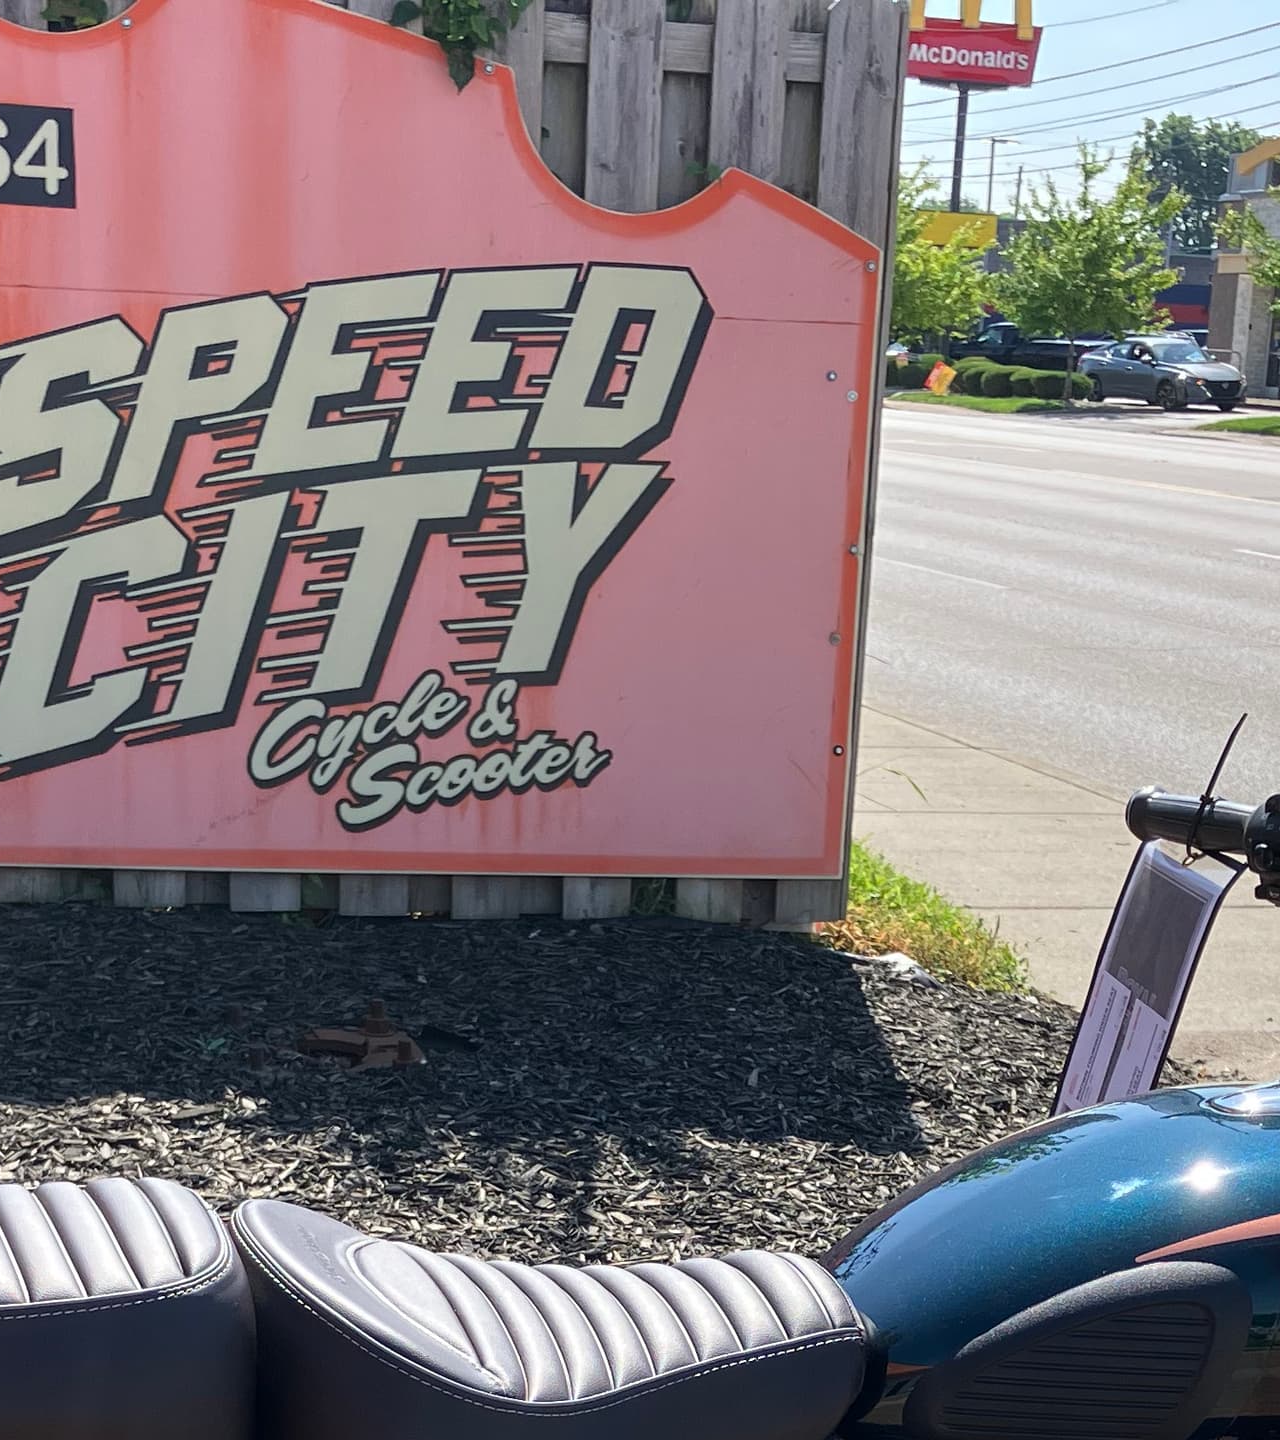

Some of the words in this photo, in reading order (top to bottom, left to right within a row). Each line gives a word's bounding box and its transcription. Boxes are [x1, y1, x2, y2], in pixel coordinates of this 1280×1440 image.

[908, 43, 1029, 70] McDonald's
[248, 669, 470, 794] Cycle
[468, 677, 520, 747] &
[335, 730, 613, 832] Scooter
